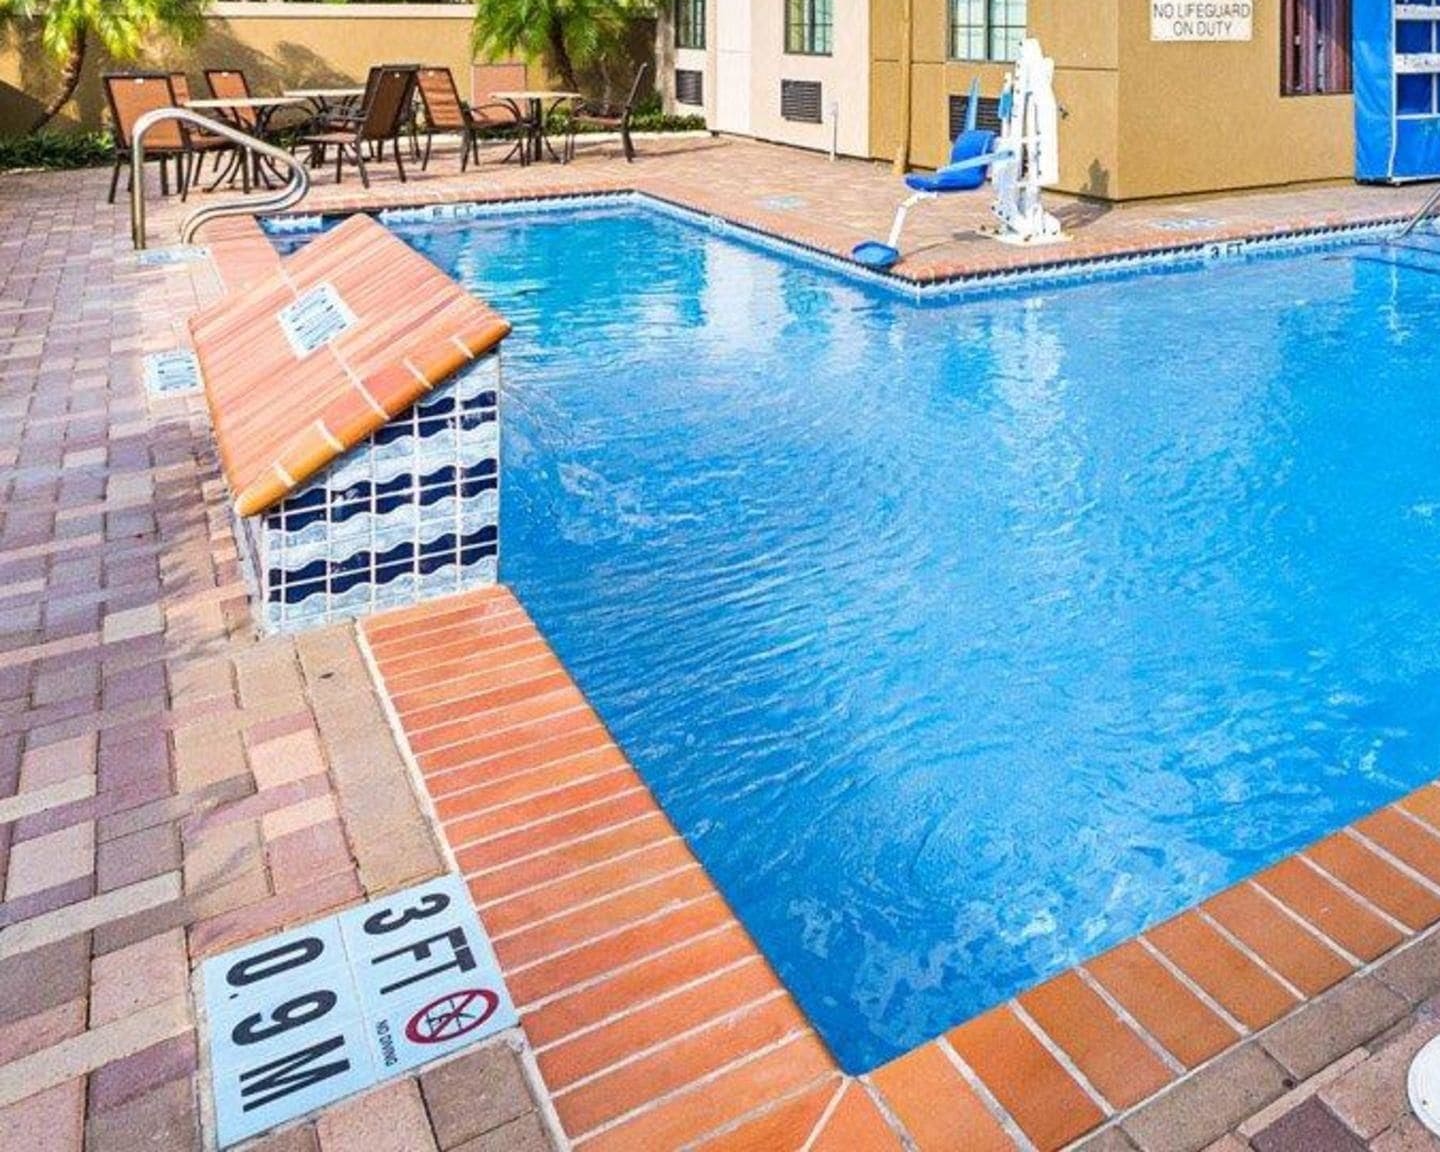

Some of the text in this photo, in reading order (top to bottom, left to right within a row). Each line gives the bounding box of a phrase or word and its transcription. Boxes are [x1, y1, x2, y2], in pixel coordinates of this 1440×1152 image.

[1153, 3, 1251, 19] NO LIFEGUARD
[1173, 20, 1232, 37] ON DUTY
[1210, 242, 1244, 259] 3 FT
[363, 892, 477, 995] 3 FT
[375, 1018, 398, 1067] NO DIVING
[239, 1034, 350, 1113] M
